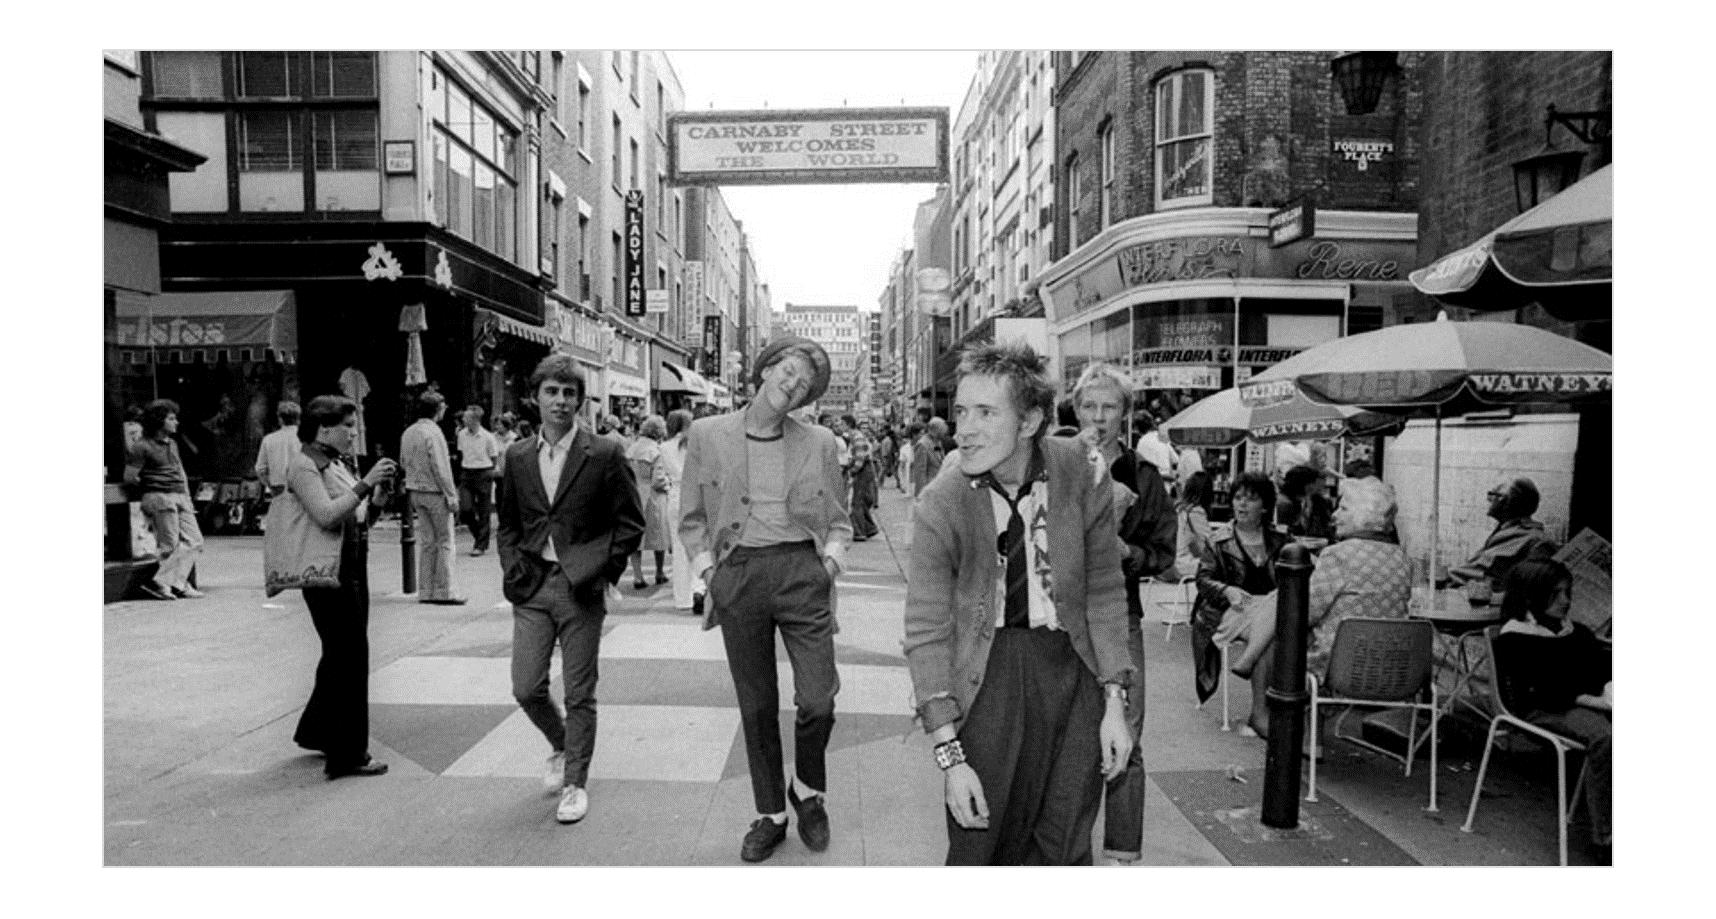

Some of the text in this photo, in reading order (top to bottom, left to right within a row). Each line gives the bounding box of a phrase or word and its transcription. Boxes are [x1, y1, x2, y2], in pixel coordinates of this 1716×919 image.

[688, 122, 927, 139] CARNABY STREET
[736, 138, 875, 153] WELCOMES
[716, 153, 899, 168] THE WORLD
[1345, 152, 1382, 161] PLACE
[629, 212, 641, 313] LADY JANE
[1141, 349, 1213, 363] INTERFLORA
[1251, 419, 1343, 438] WATNEYS
